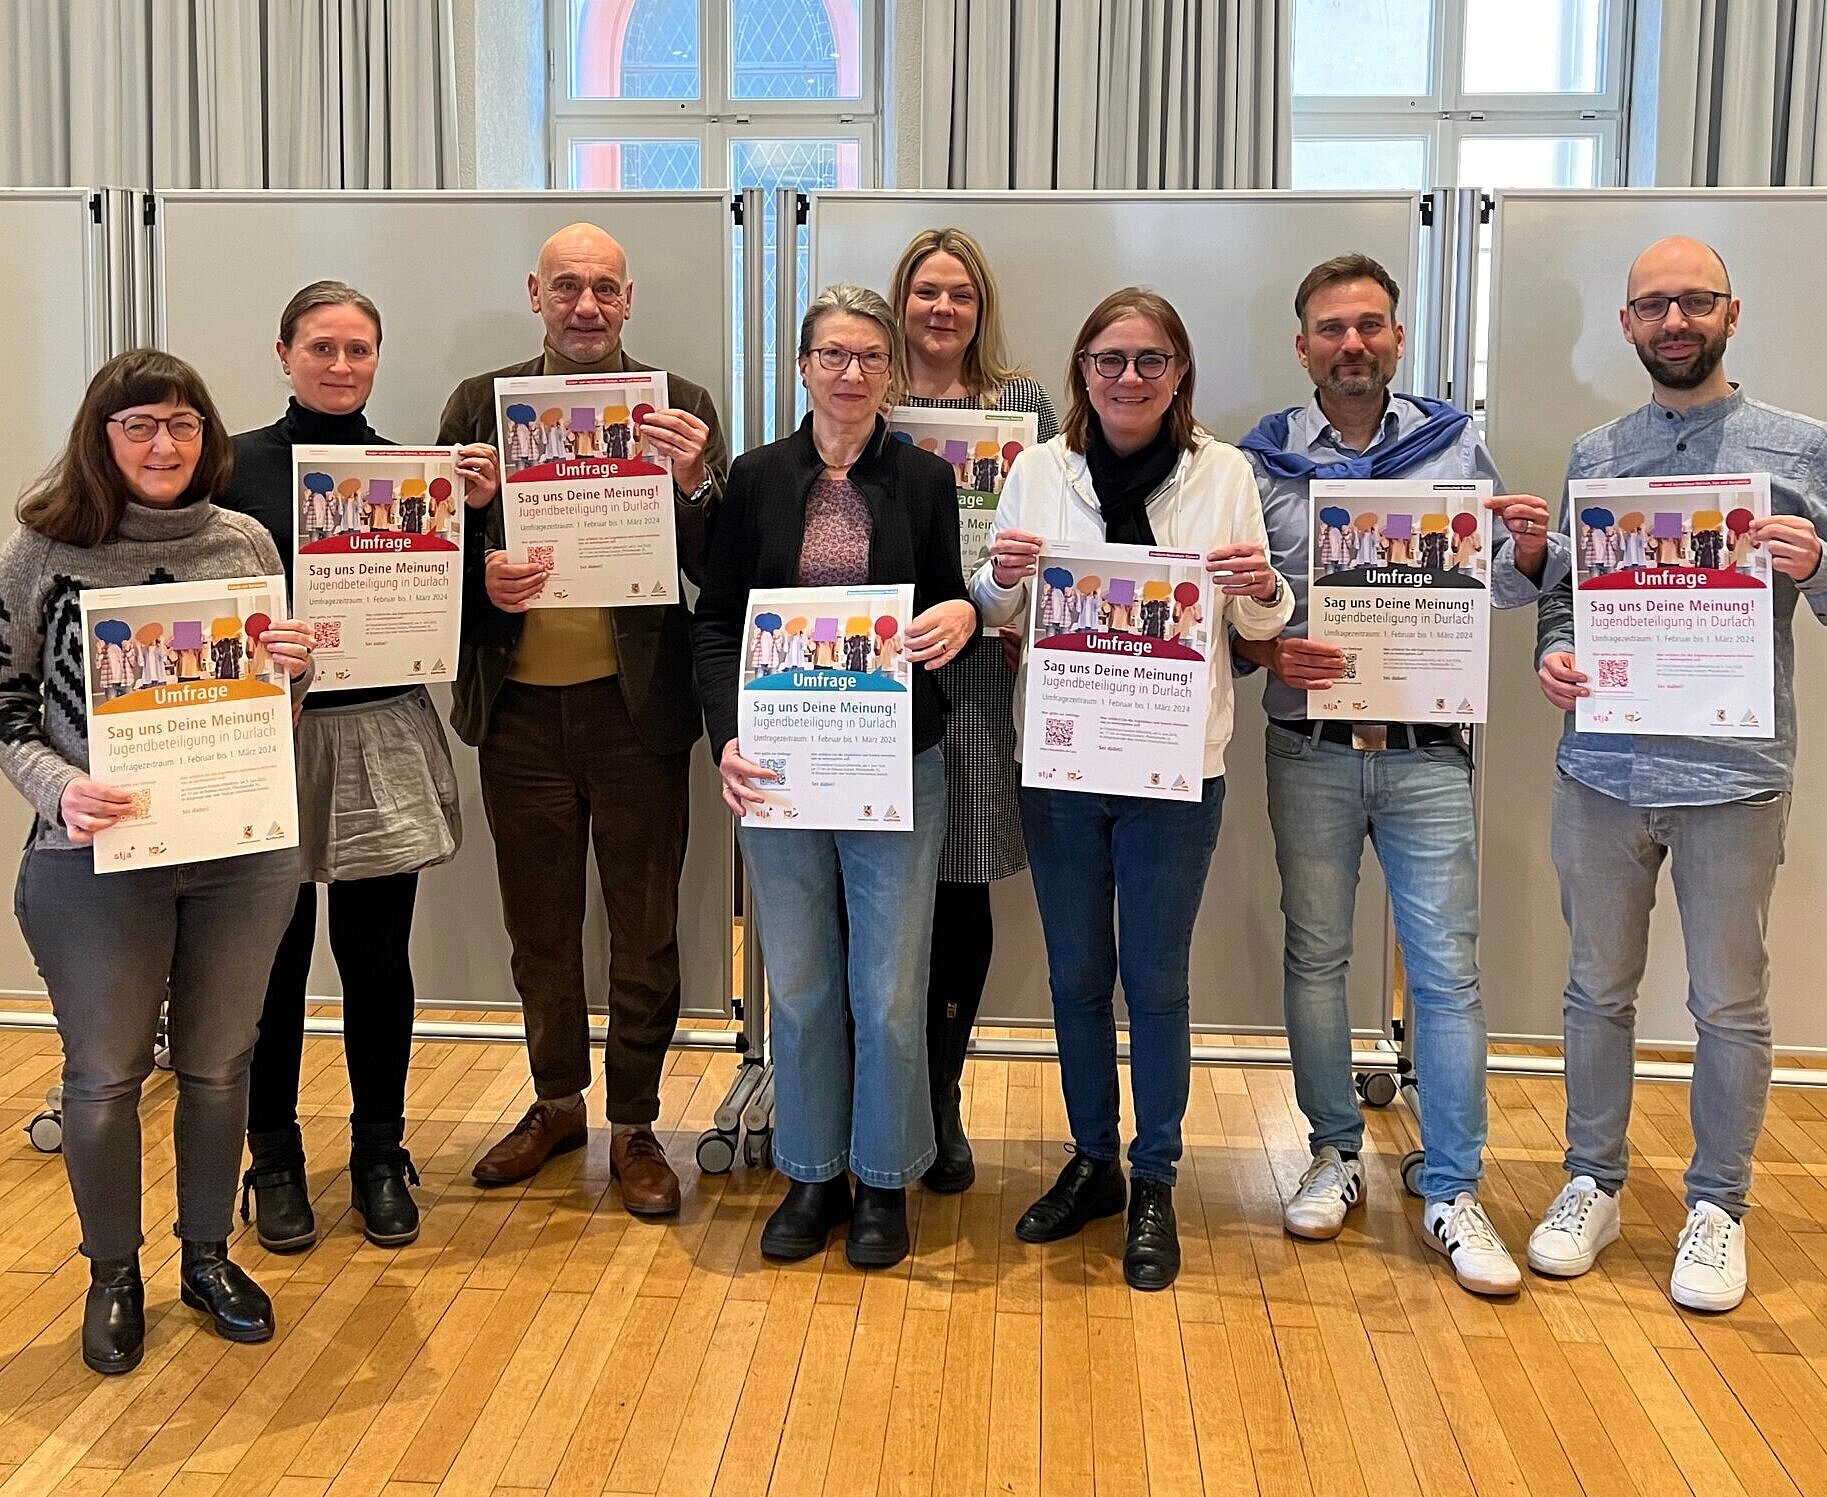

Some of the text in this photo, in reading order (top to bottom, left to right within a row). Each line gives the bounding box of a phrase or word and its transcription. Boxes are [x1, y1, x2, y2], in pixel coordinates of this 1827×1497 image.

[556, 461, 618, 477] Umfrage
[518, 485, 658, 505] Sag uns Deine Meinung!
[519, 499, 660, 519] Jugendbeteiligung in Durlach
[644, 517, 660, 525] 2024
[350, 535, 411, 552] Umfrage
[309, 561, 448, 578] Sag uns Deine Meinung!
[1366, 569, 1432, 587] Umfrage
[309, 575, 449, 593] Jugendbeteiligung in Durlach
[1634, 570, 1706, 588] Umfrage
[1324, 597, 1473, 613] Sag uns Deine Meinung!
[1590, 600, 1754, 615] Sag uns Deine Meinung!
[1324, 612, 1473, 626] Jugendbeteiligung in Durlach
[1591, 615, 1754, 630] Jugendbeteiligung in Durlach
[1087, 635, 1152, 655] Umfrage
[1735, 635, 1754, 643] 2024
[1044, 659, 1192, 685] Sag uns Deine Meinung!
[793, 672, 856, 690] Umfrage
[1043, 675, 1191, 697] Jugendbeteiligung in Durlach
[155, 685, 227, 704] Umfrage
[753, 701, 896, 716] Sag uns Deine Meinung!
[107, 708, 274, 740] Sag uns Deine Meinung!
[754, 716, 896, 730] Jugendbeteiligung in Durlach
[109, 724, 276, 757] Jugendbeteiligung in Durlach
[259, 745, 276, 754] 2024
